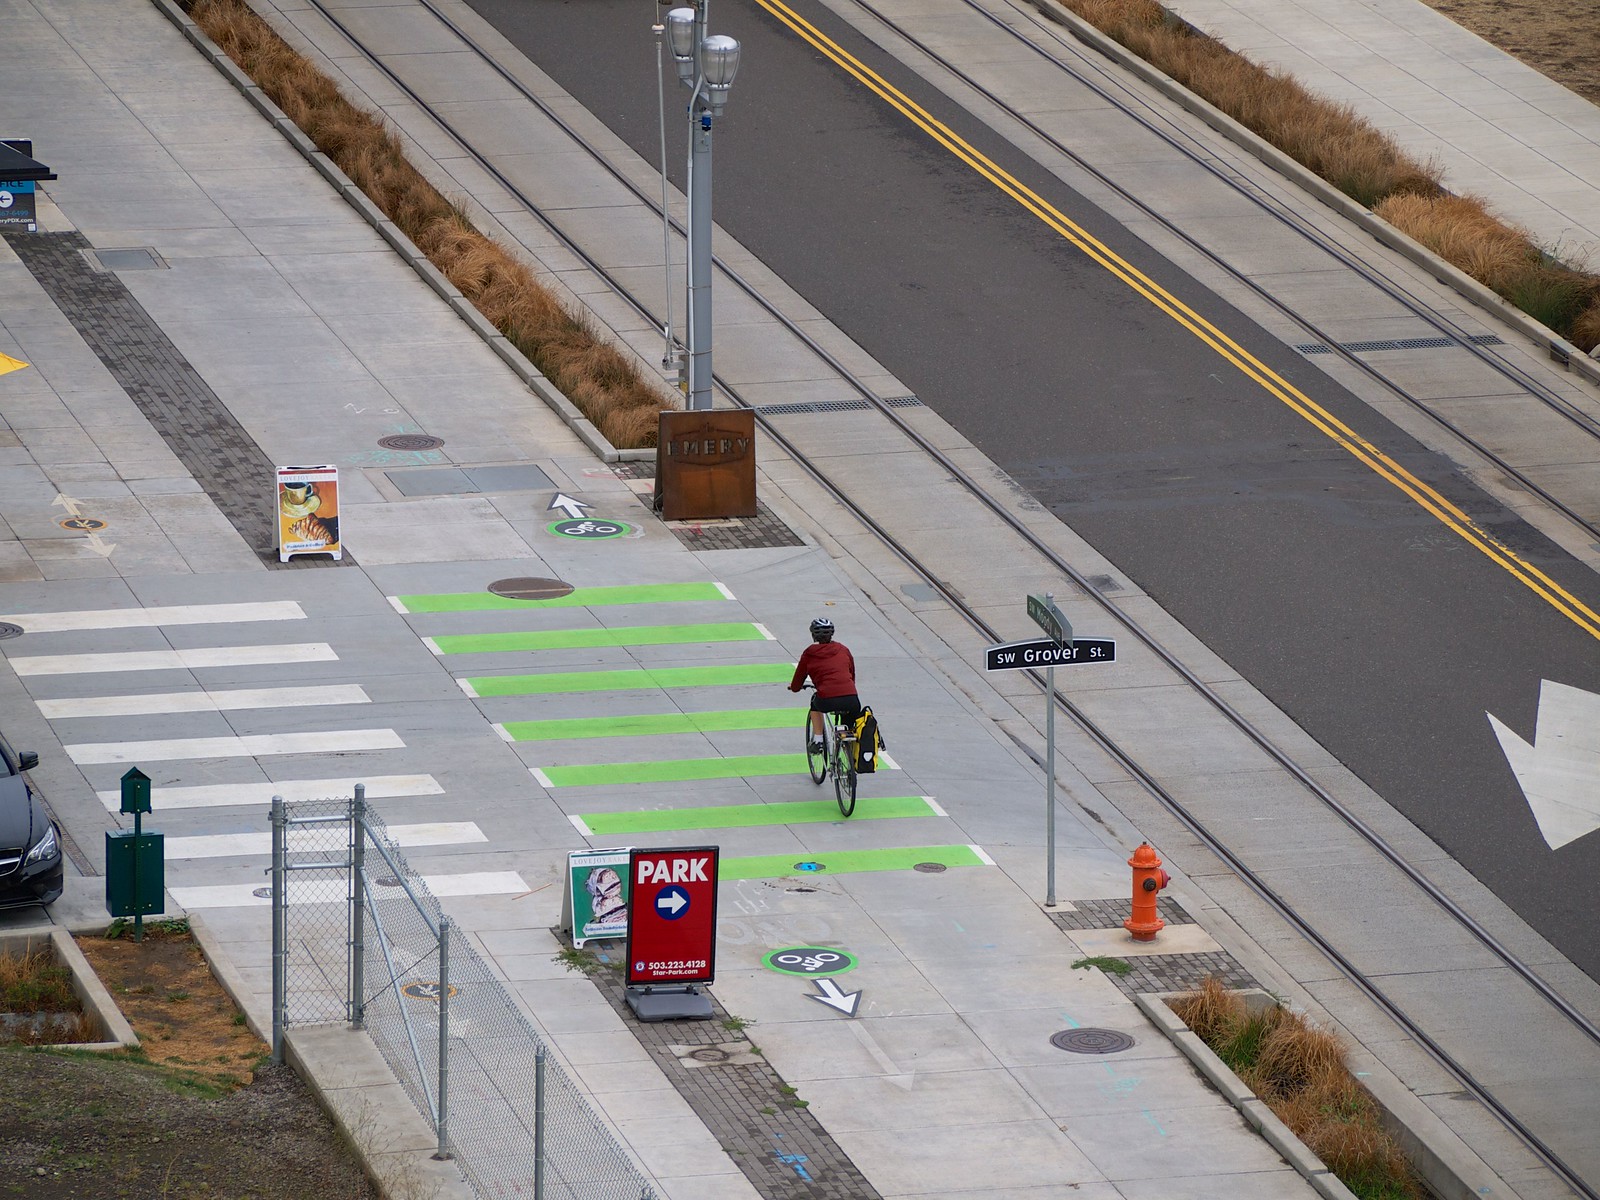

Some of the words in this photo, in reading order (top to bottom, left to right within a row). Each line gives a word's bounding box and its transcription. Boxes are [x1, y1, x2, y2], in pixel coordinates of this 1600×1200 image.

[666, 438, 750, 456] EMERY
[997, 652, 1016, 665] SW
[1023, 646, 1079, 663] Grover
[1090, 646, 1106, 658] St.
[573, 856, 607, 865] LOVEJOY
[637, 857, 709, 885] PARK
[648, 959, 707, 970] 503.223.4128
[652, 968, 699, 976] Star-Park.com
